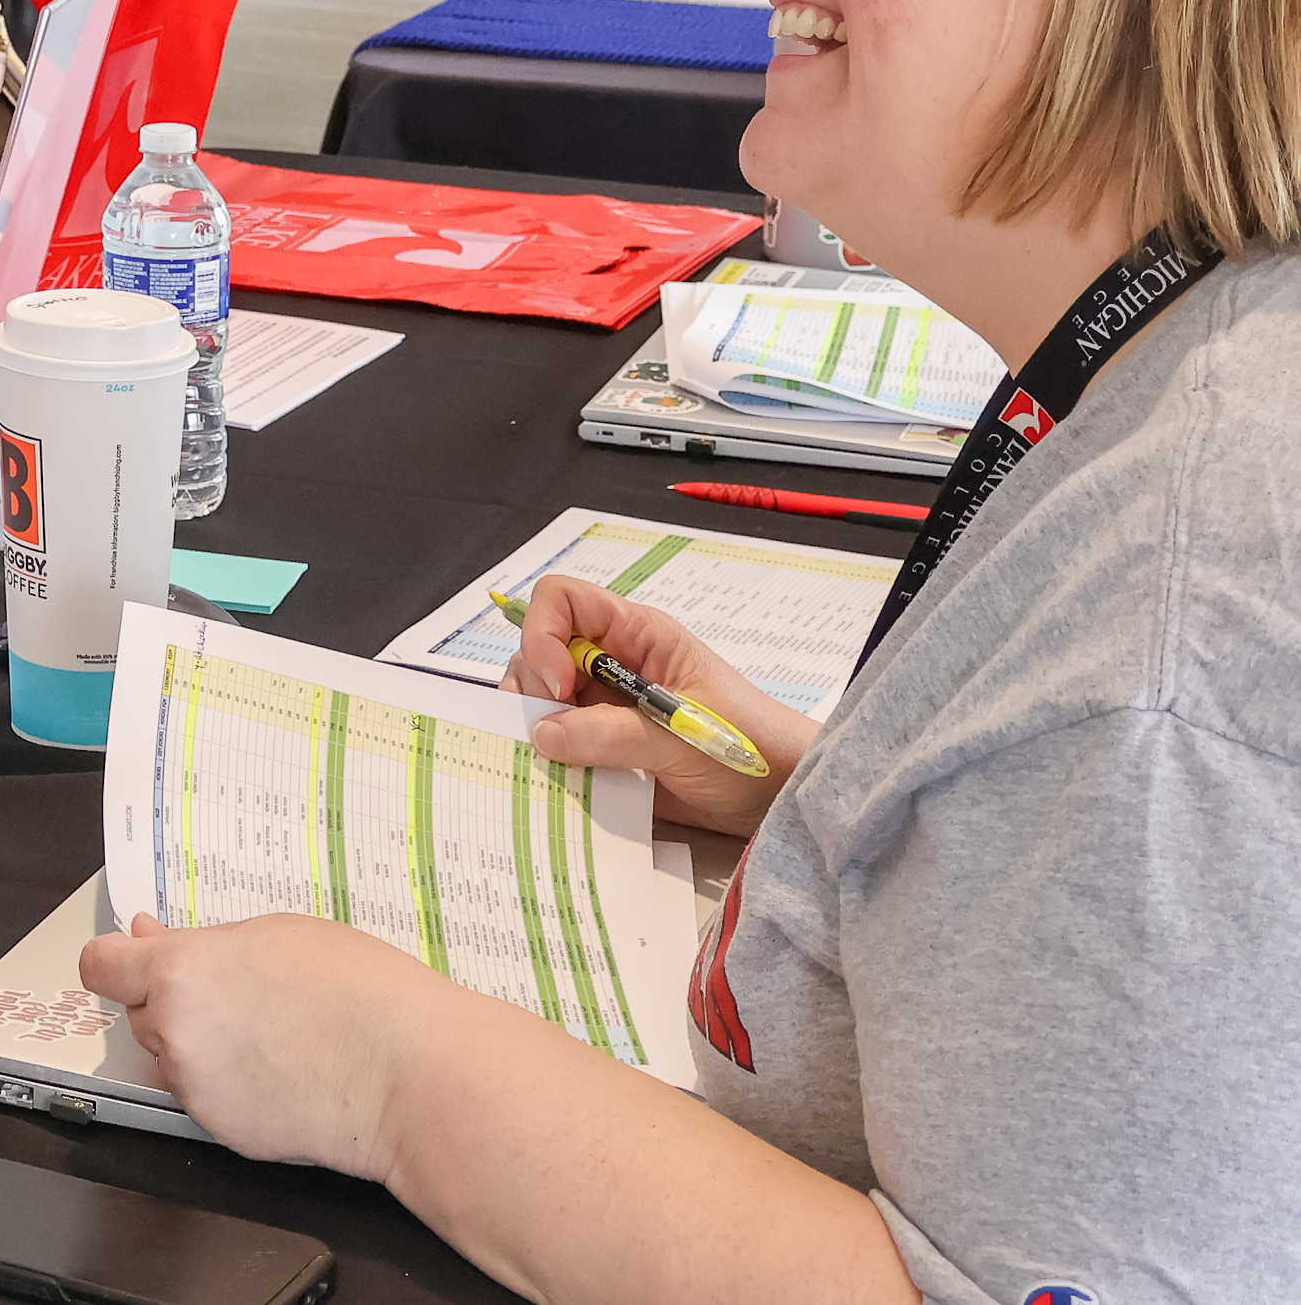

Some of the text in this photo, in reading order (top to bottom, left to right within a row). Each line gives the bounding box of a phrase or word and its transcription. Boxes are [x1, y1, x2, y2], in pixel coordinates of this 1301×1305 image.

[1071, 245, 1156, 329] LEGE
[106, 384, 135, 393] 24oz
[898, 432, 1003, 600] COLLEGE
[5, 569, 48, 599] OFFEE
[598, 657, 636, 685] Sharpie
[7, 1001, 49, 1023] FOR
[18, 990, 91, 1041] GRATEFUL
